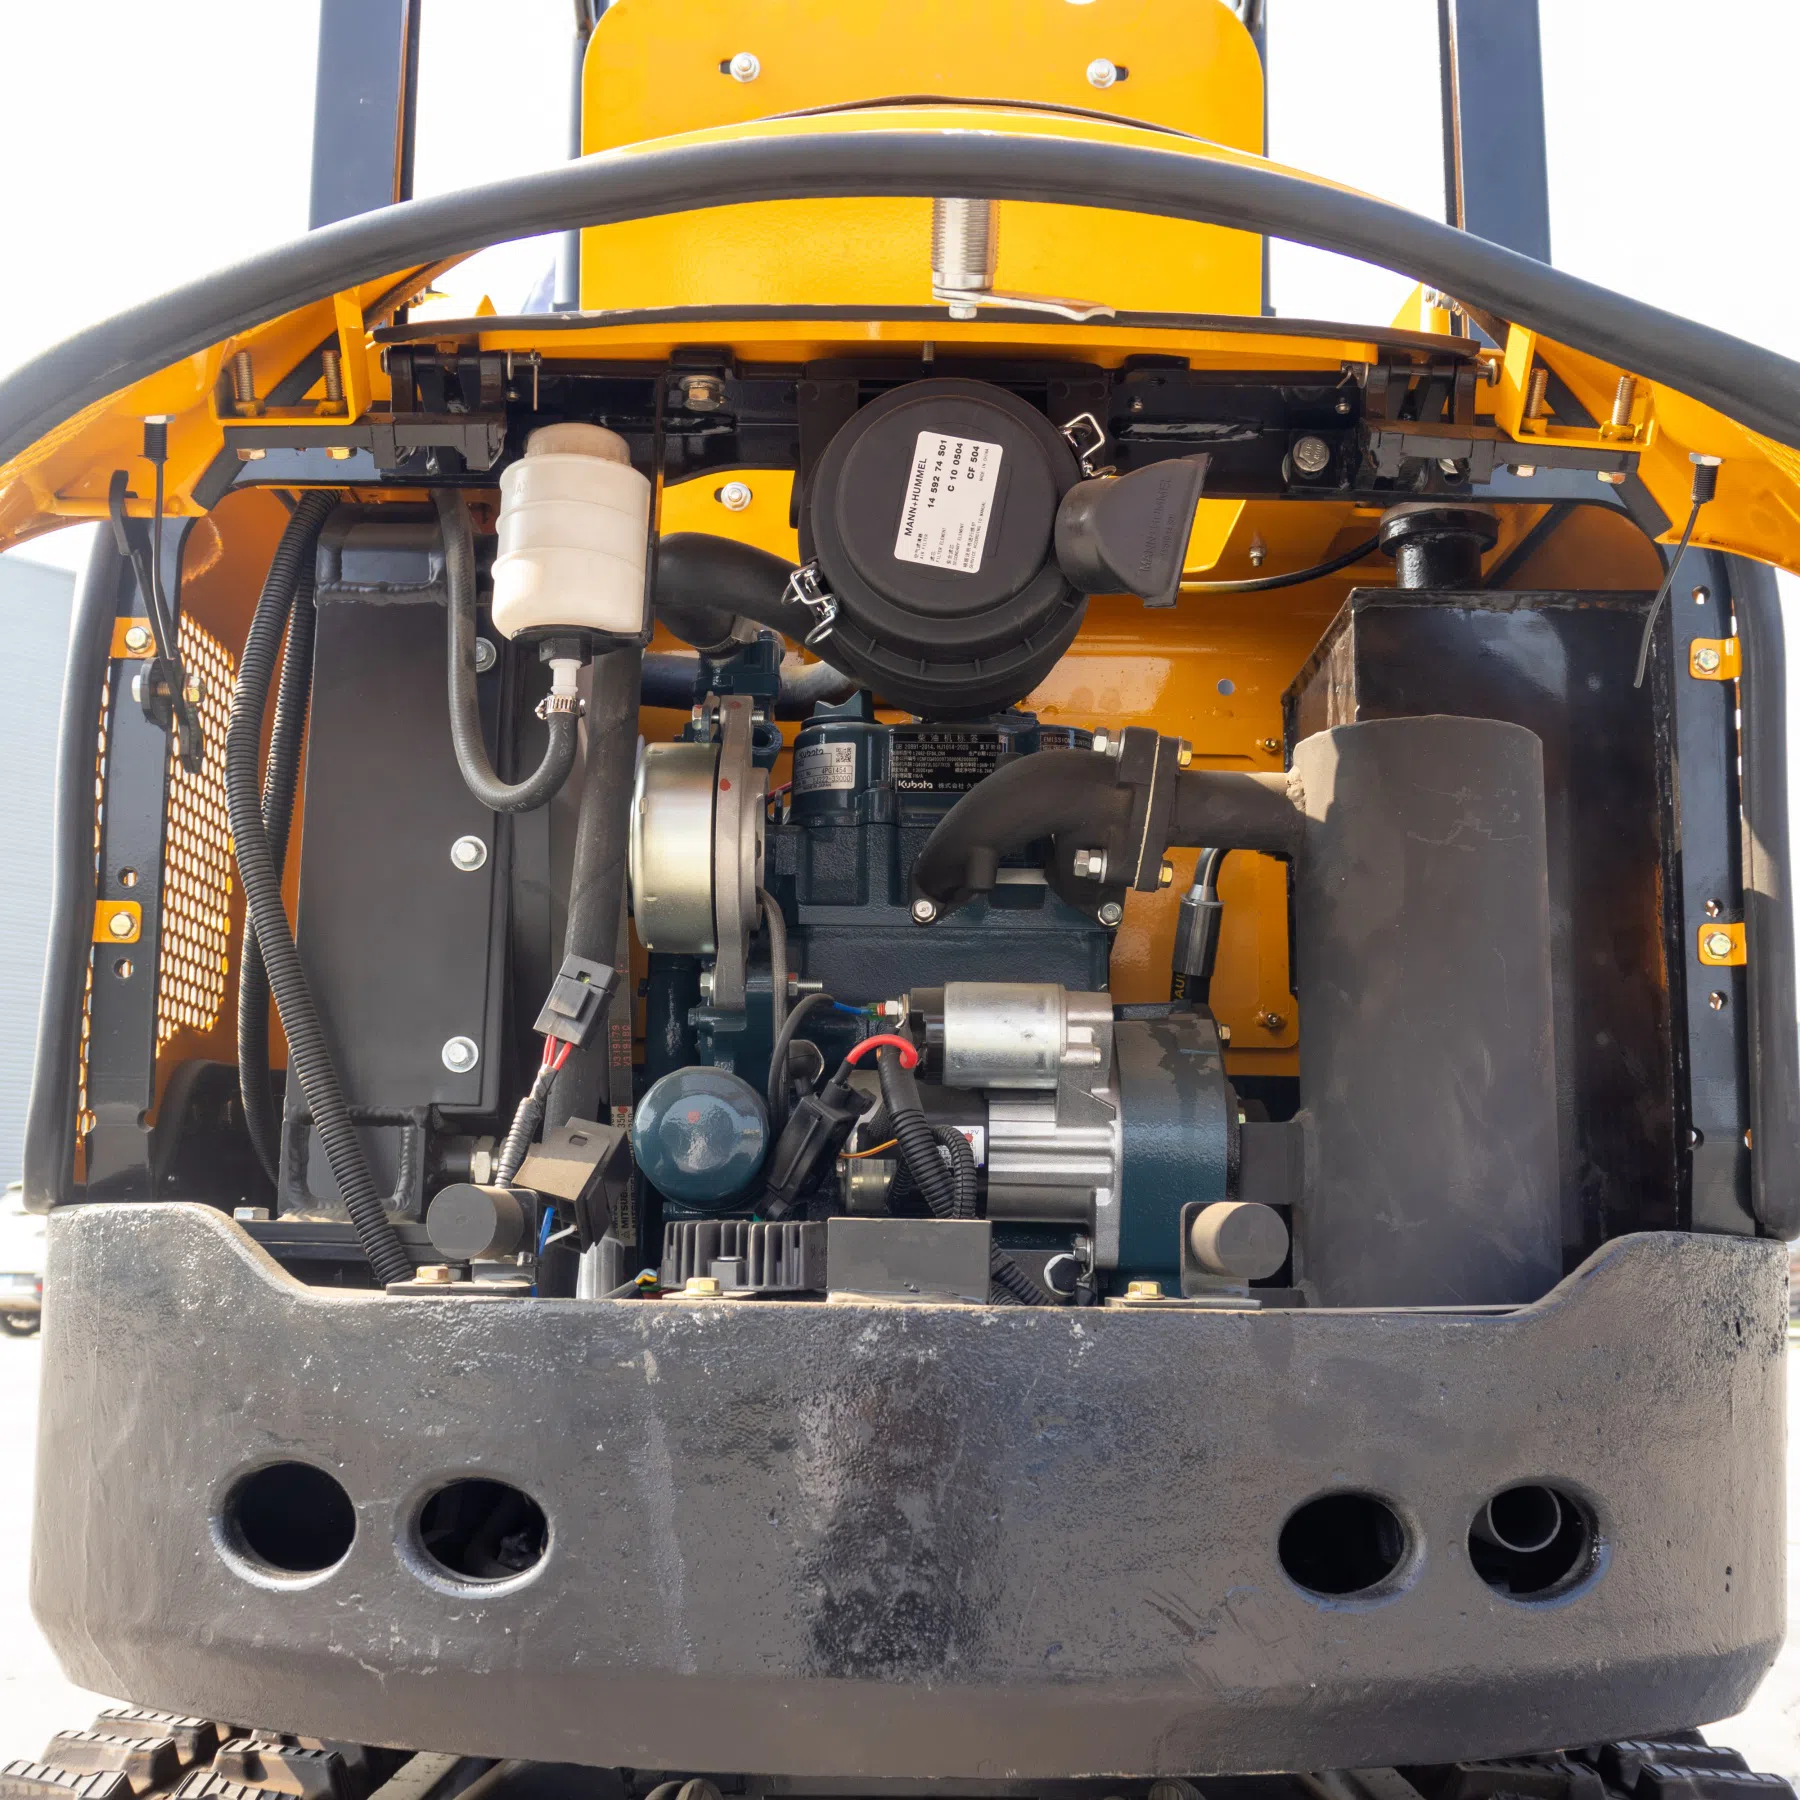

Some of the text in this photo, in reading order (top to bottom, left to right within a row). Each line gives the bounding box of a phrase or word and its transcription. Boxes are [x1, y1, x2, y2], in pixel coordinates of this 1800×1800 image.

[952, 442, 963, 466] 0504
[967, 445, 980, 480] CF 504
[927, 439, 947, 508] 14 592 74 S01
[949, 469, 958, 481] 10
[904, 458, 928, 536] MANN+HUMMEL
[898, 780, 934, 789] Kubota
[619, 1190, 630, 1229] MITSUB
